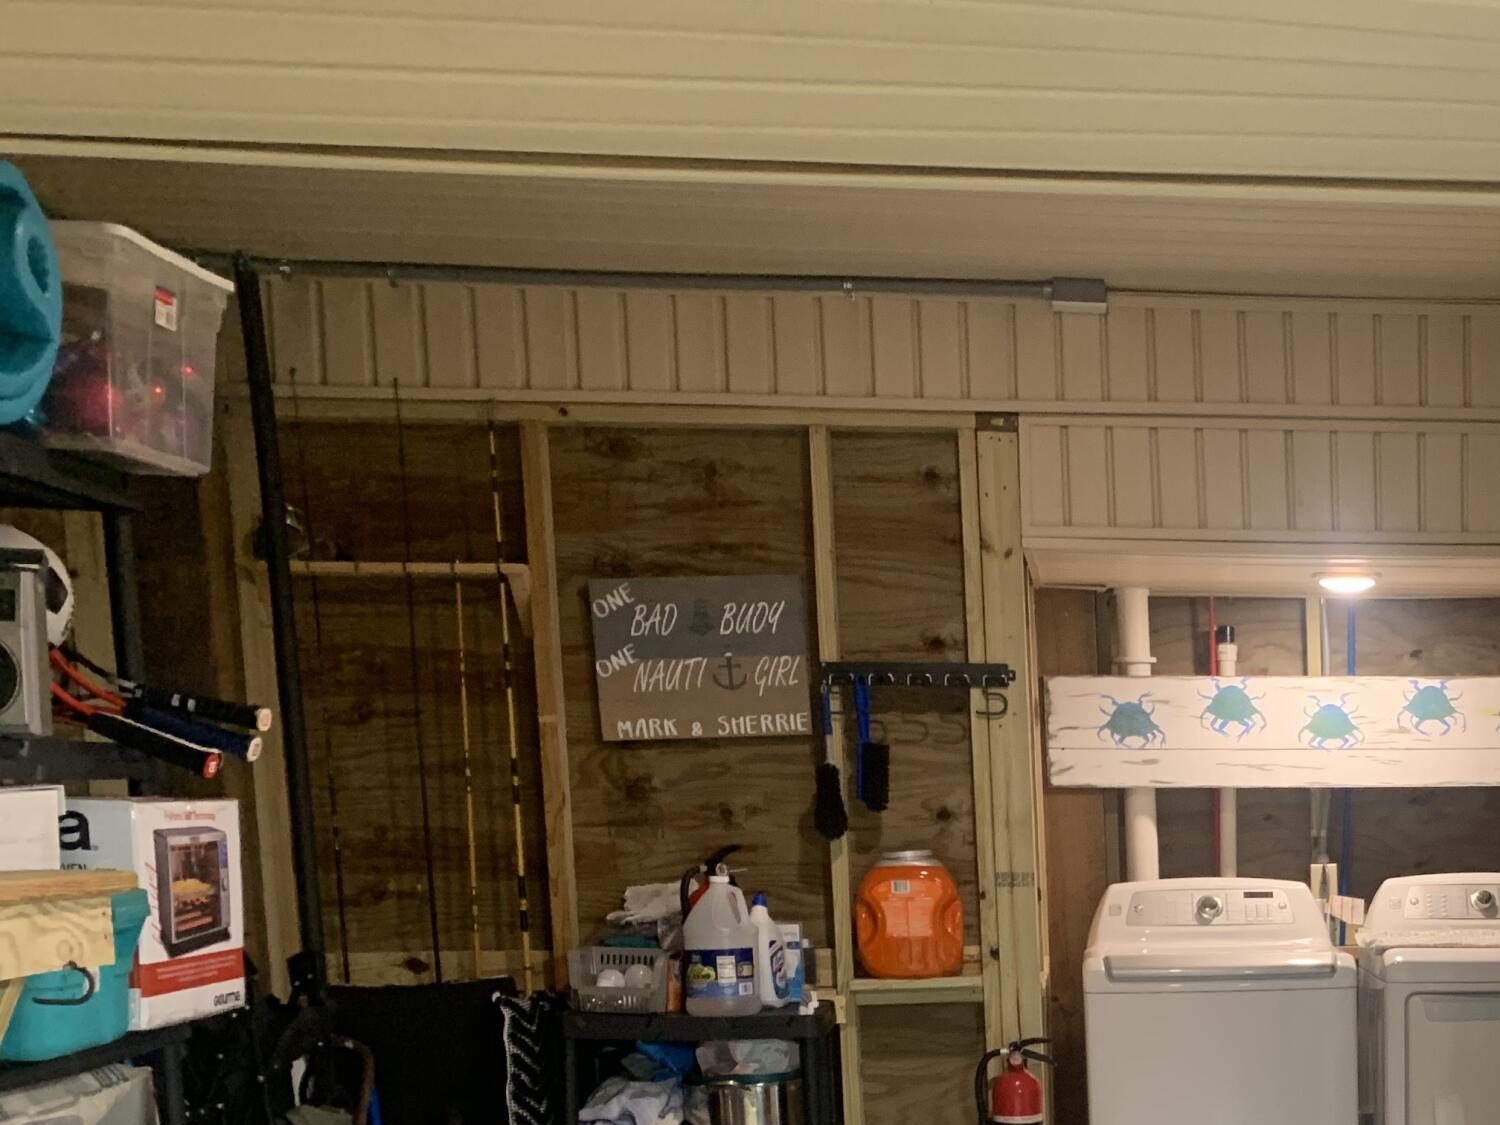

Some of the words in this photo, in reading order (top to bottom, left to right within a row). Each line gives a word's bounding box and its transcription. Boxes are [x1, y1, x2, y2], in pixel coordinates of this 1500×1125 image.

[593, 582, 635, 618] ONE
[631, 603, 678, 637] BAD
[720, 600, 785, 635] BUOY
[596, 643, 640, 678] ONE
[633, 657, 708, 693] NAUTI
[754, 655, 800, 696] GIRL
[617, 718, 678, 739] MARK
[691, 721, 704, 737] &
[717, 712, 809, 736] SHERRIE
